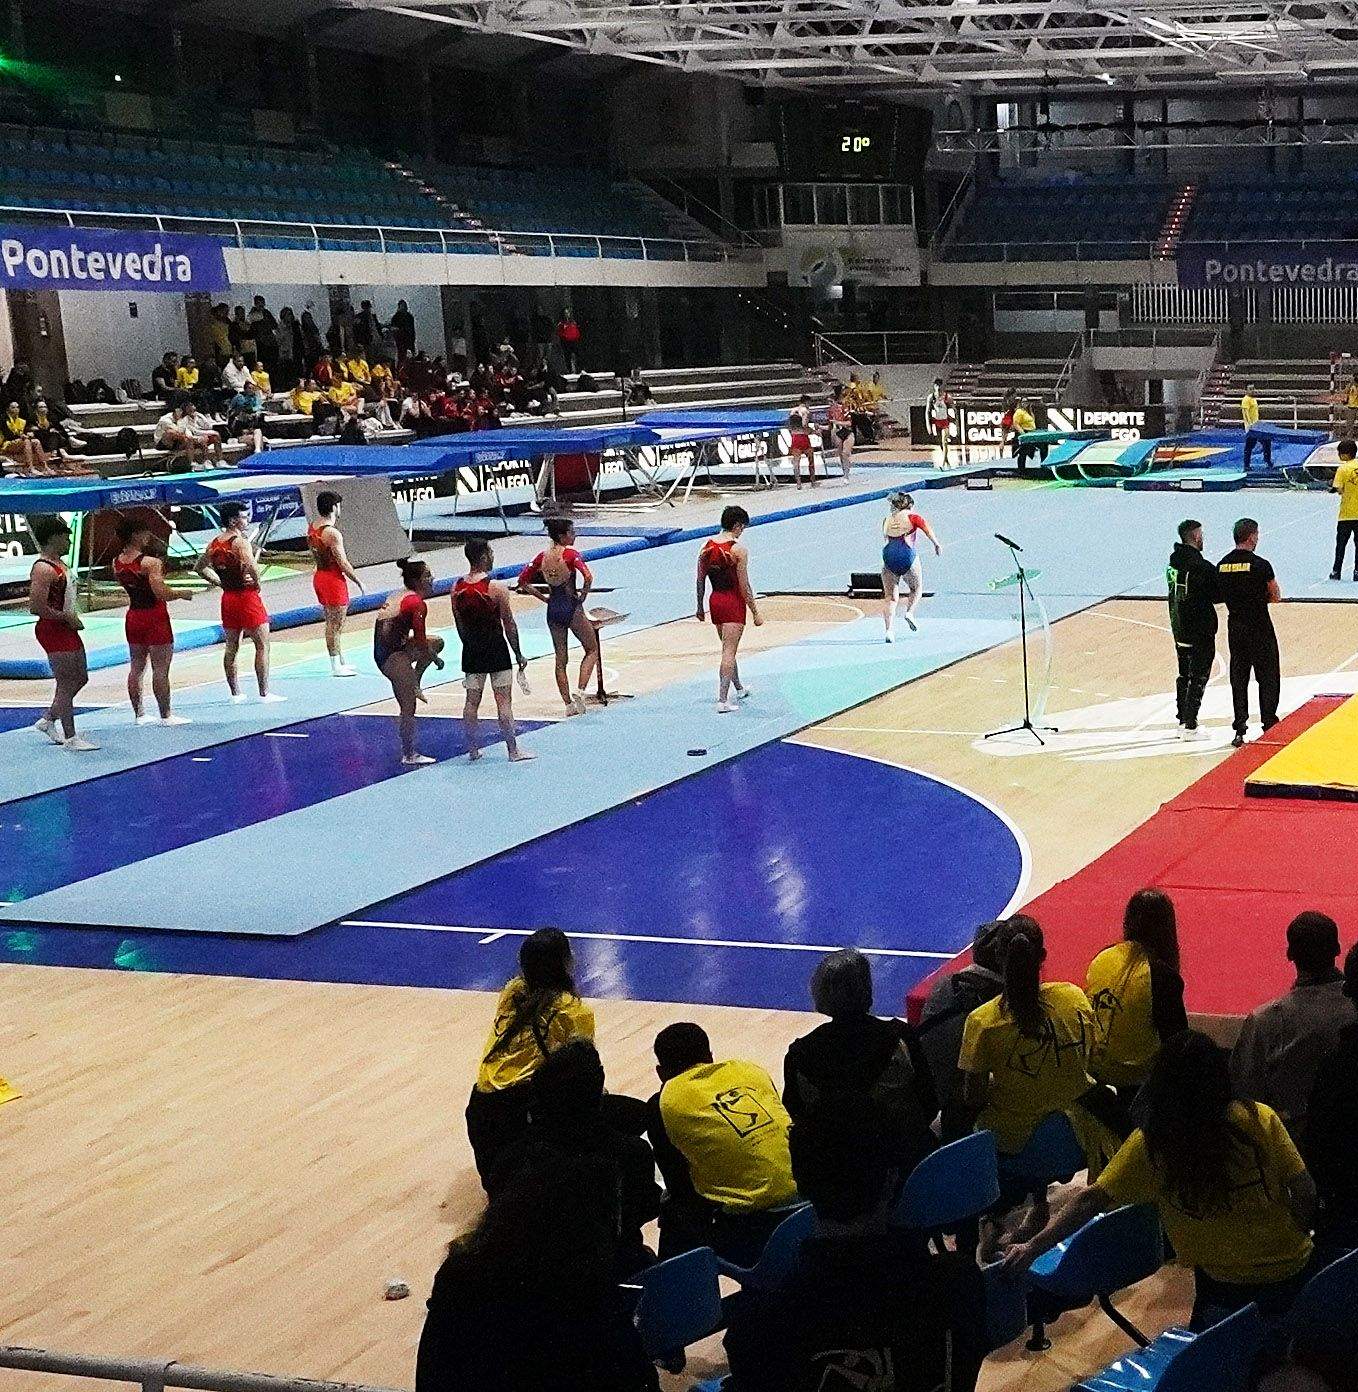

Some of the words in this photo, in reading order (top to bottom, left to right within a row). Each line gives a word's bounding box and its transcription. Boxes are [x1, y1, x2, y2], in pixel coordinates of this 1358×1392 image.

[1, 238, 192, 282] Pontevedra
[966, 411, 1004, 425] DEPO
[1083, 411, 1145, 425] DEPORTE
